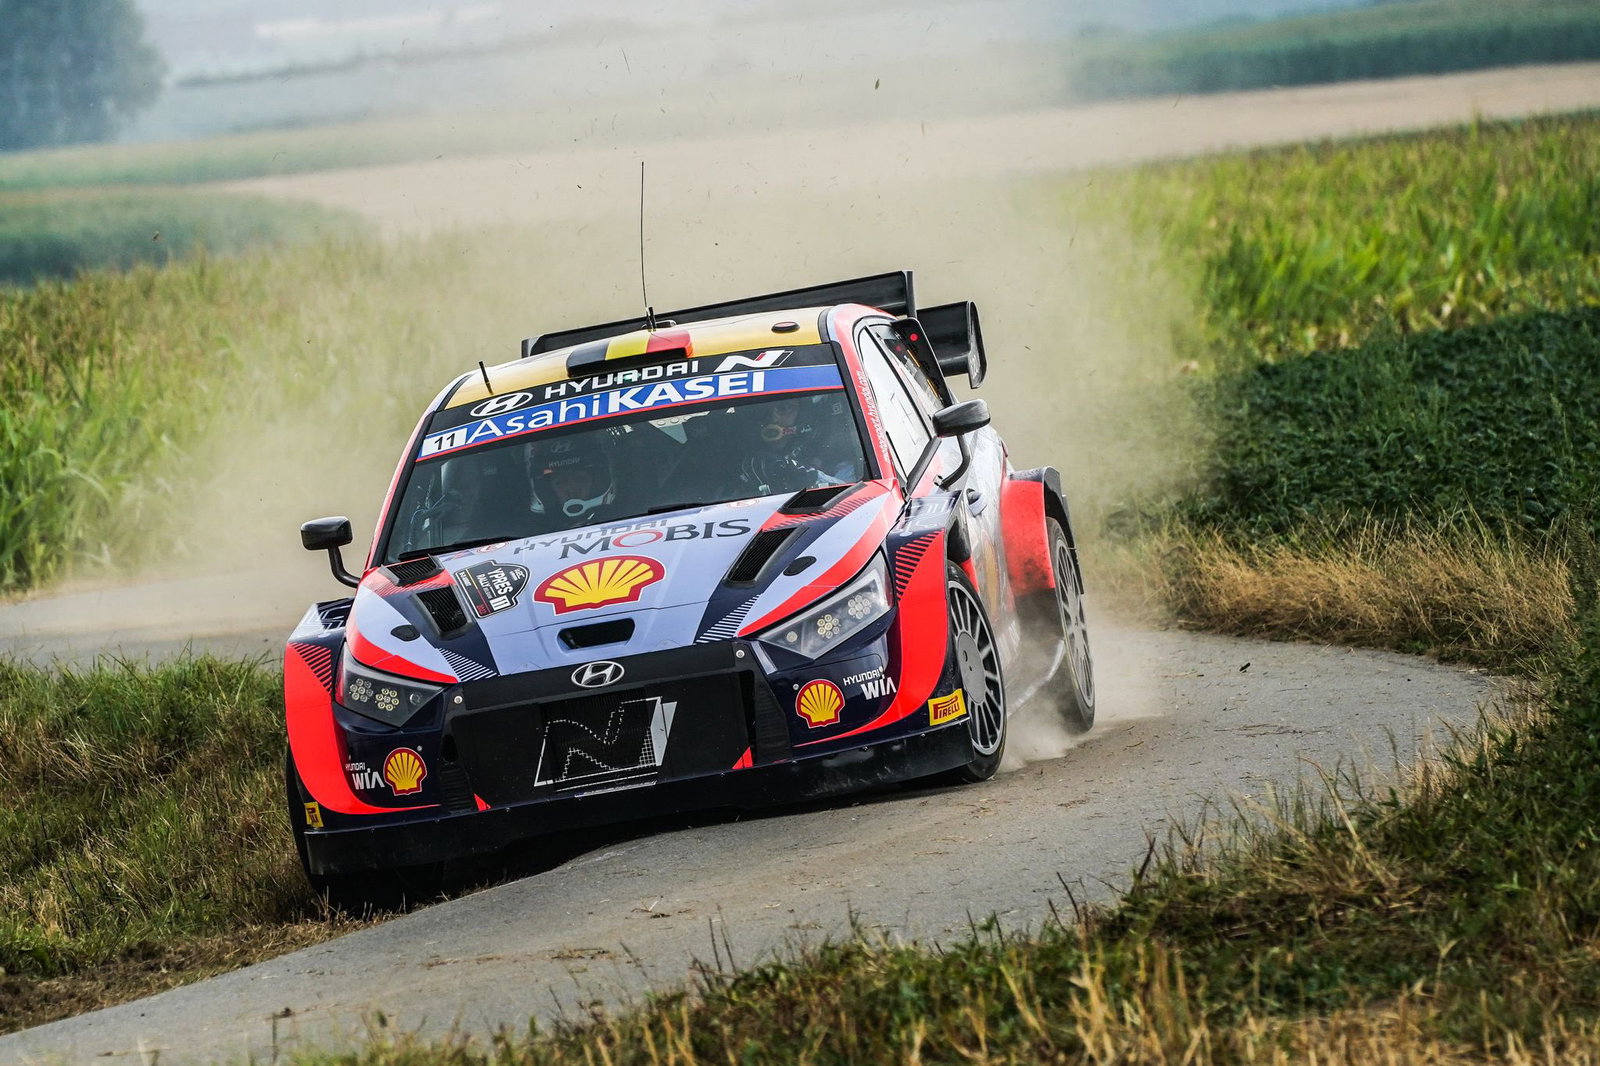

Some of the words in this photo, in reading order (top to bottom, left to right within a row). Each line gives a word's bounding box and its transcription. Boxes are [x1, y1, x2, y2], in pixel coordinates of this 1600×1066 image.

[434, 433, 456, 451] 11
[513, 519, 668, 555] HYUNDAI
[559, 518, 751, 560] MOBIS
[487, 567, 514, 596] YPRES
[843, 668, 881, 686] HYUNDAI
[933, 694, 961, 720] PIRELLI
